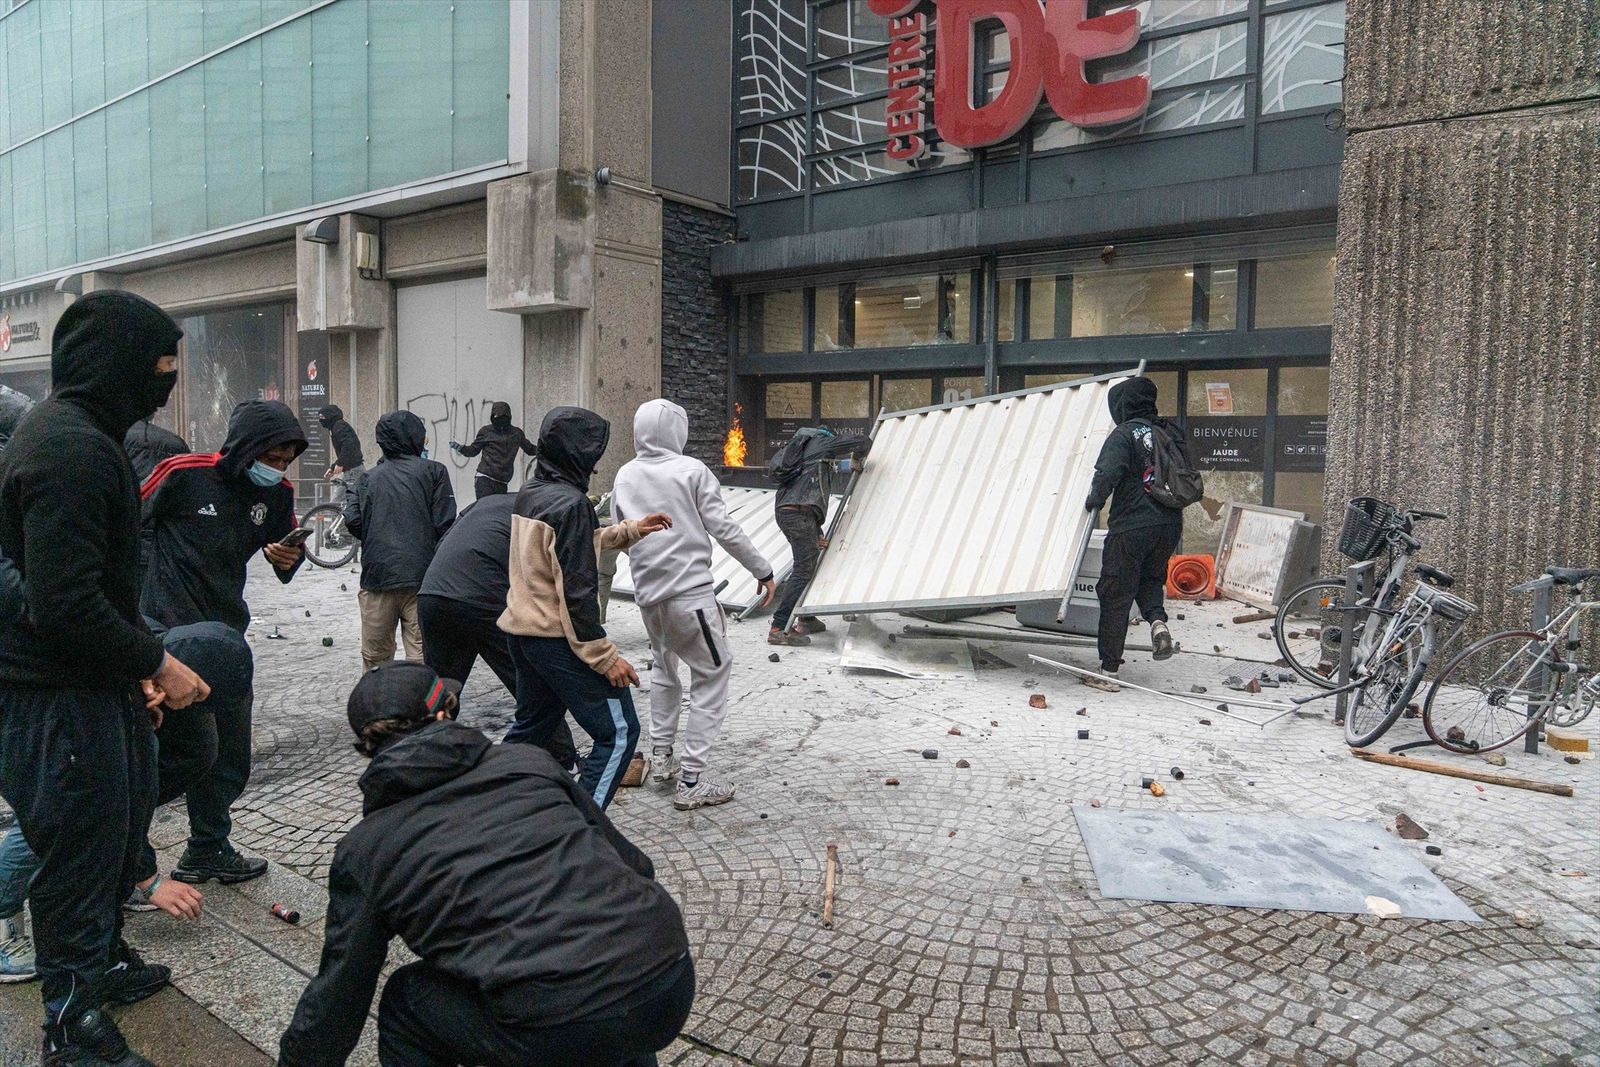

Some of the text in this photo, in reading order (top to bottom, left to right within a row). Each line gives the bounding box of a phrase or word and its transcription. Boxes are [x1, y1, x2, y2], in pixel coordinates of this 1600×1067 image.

[886, 12, 927, 161] CENTRE
[944, 378, 972, 387] PORTE
[943, 388, 972, 404] 01
[833, 427, 865, 436] NVENUE
[1193, 427, 1259, 438] BIENVENUE
